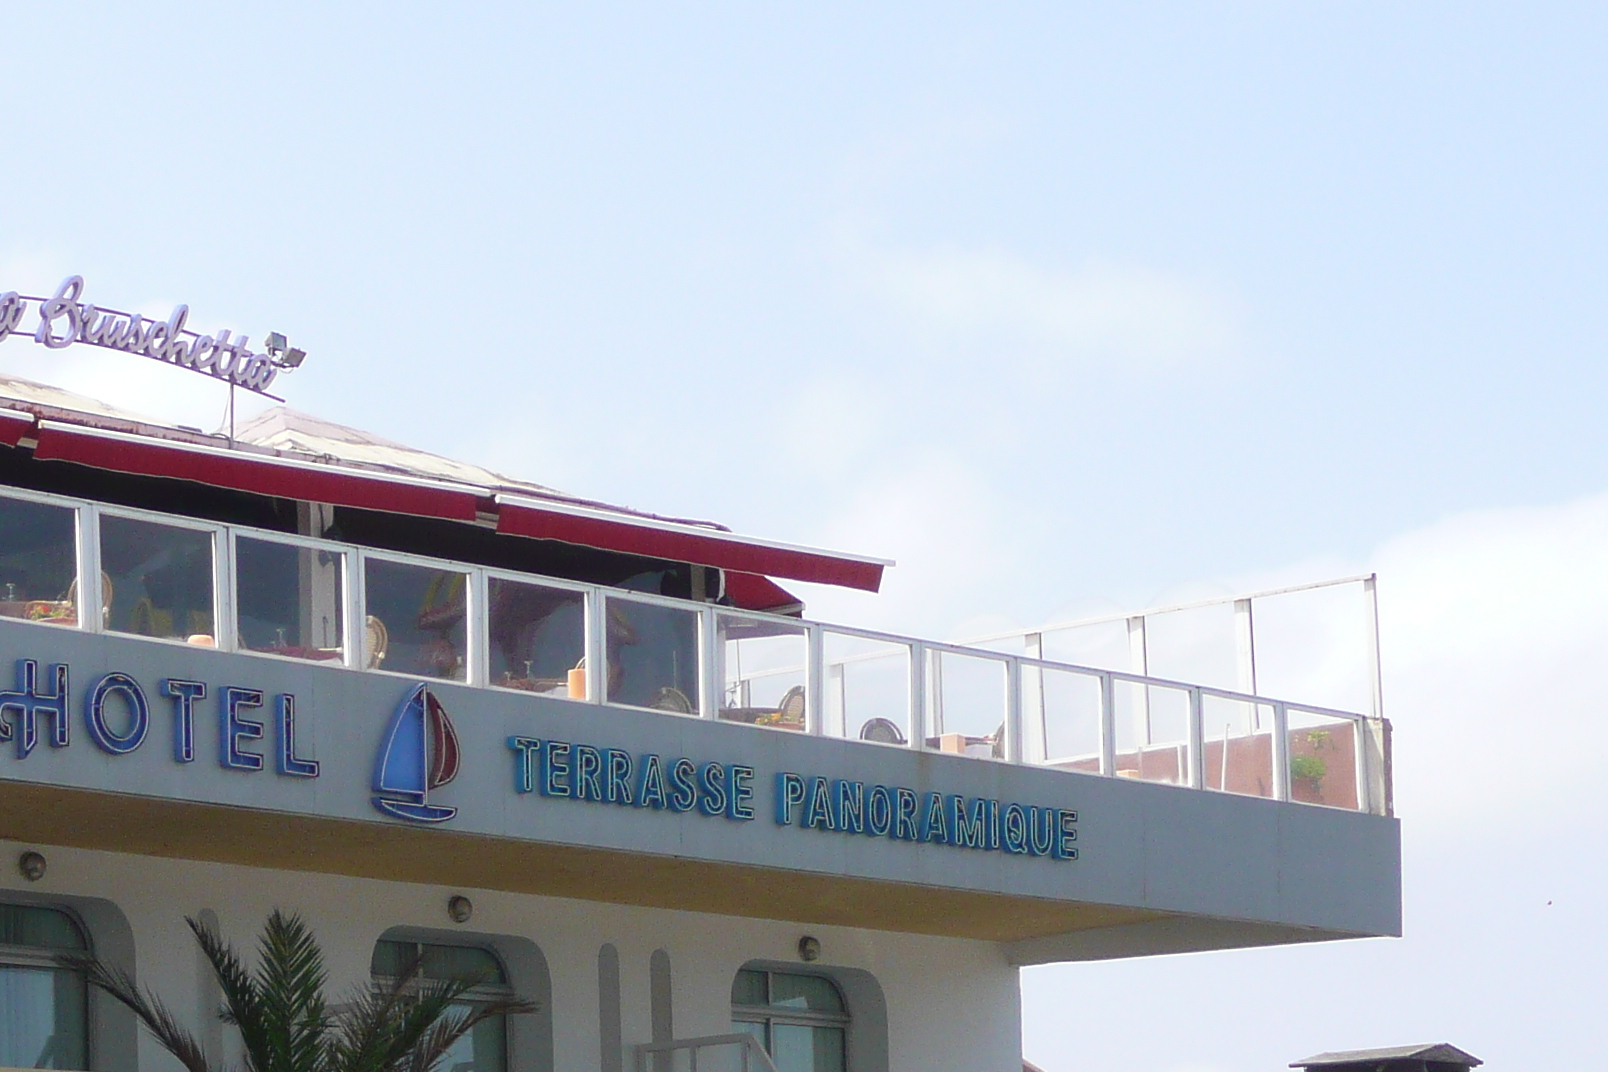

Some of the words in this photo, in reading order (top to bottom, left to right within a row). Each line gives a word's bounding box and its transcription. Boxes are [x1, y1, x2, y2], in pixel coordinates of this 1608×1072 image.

[35, 275, 278, 392] Bruschetta
[507, 735, 755, 821] TERRASSE
[776, 771, 1079, 860] PANORAMIQUE
